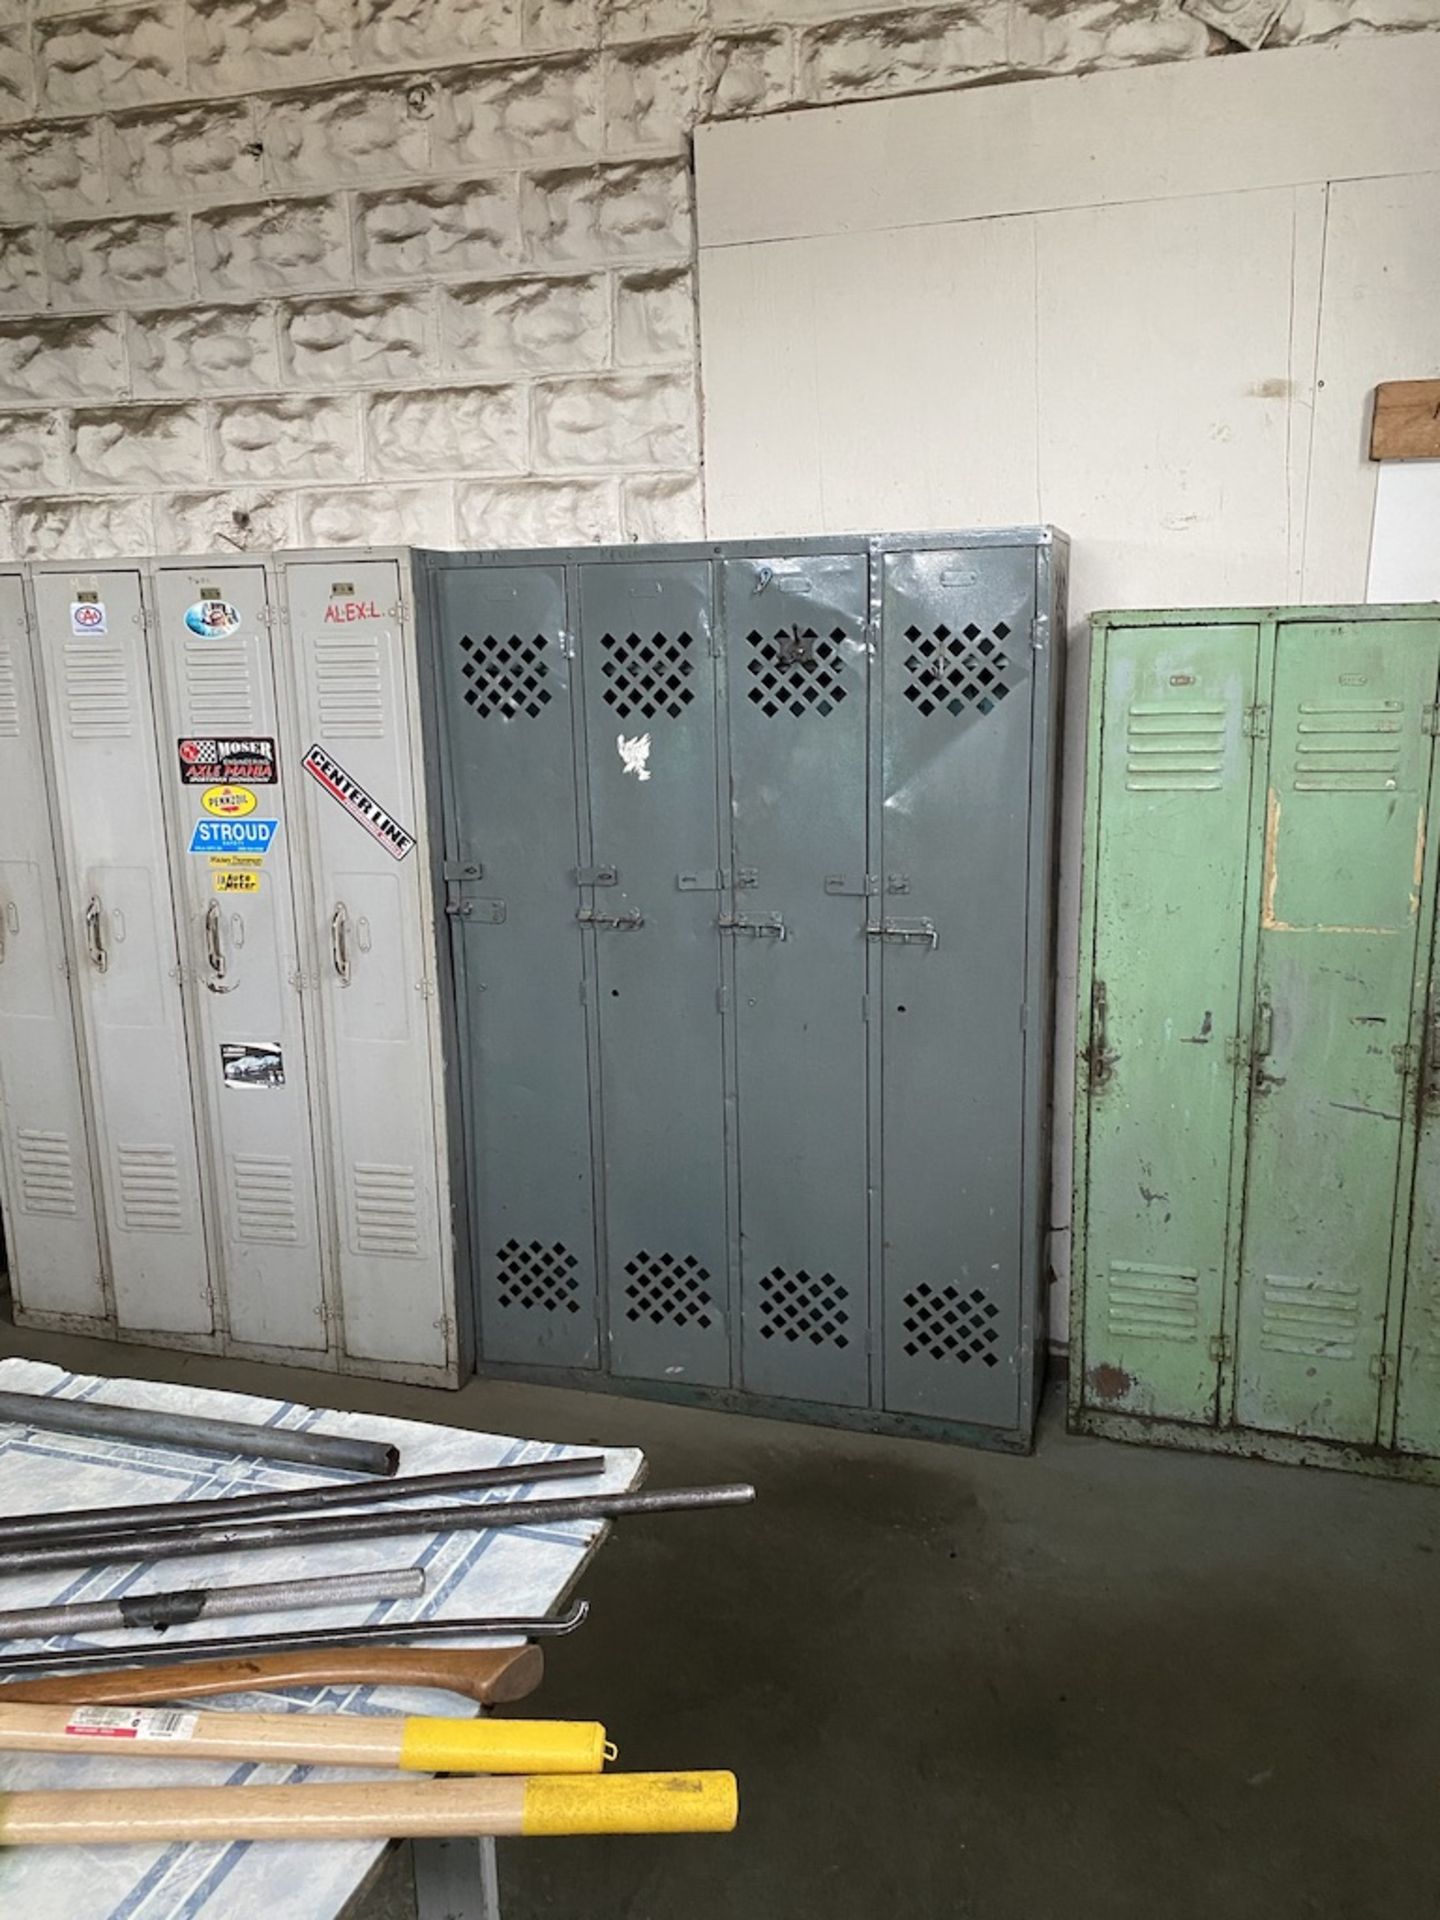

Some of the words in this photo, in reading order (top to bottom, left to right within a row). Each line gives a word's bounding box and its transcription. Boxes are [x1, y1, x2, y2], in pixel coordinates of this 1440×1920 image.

[217, 740, 273, 762] MOSER
[185, 764, 222, 777] AXLE
[224, 764, 273, 777] MANIA
[208, 794, 249, 807] PENNZOIL
[311, 750, 373, 814] CENTER
[372, 811, 411, 849] LINE
[199, 823, 270, 841] STROUD
[226, 873, 251, 882] Auto
[225, 881, 257, 890] Meter
